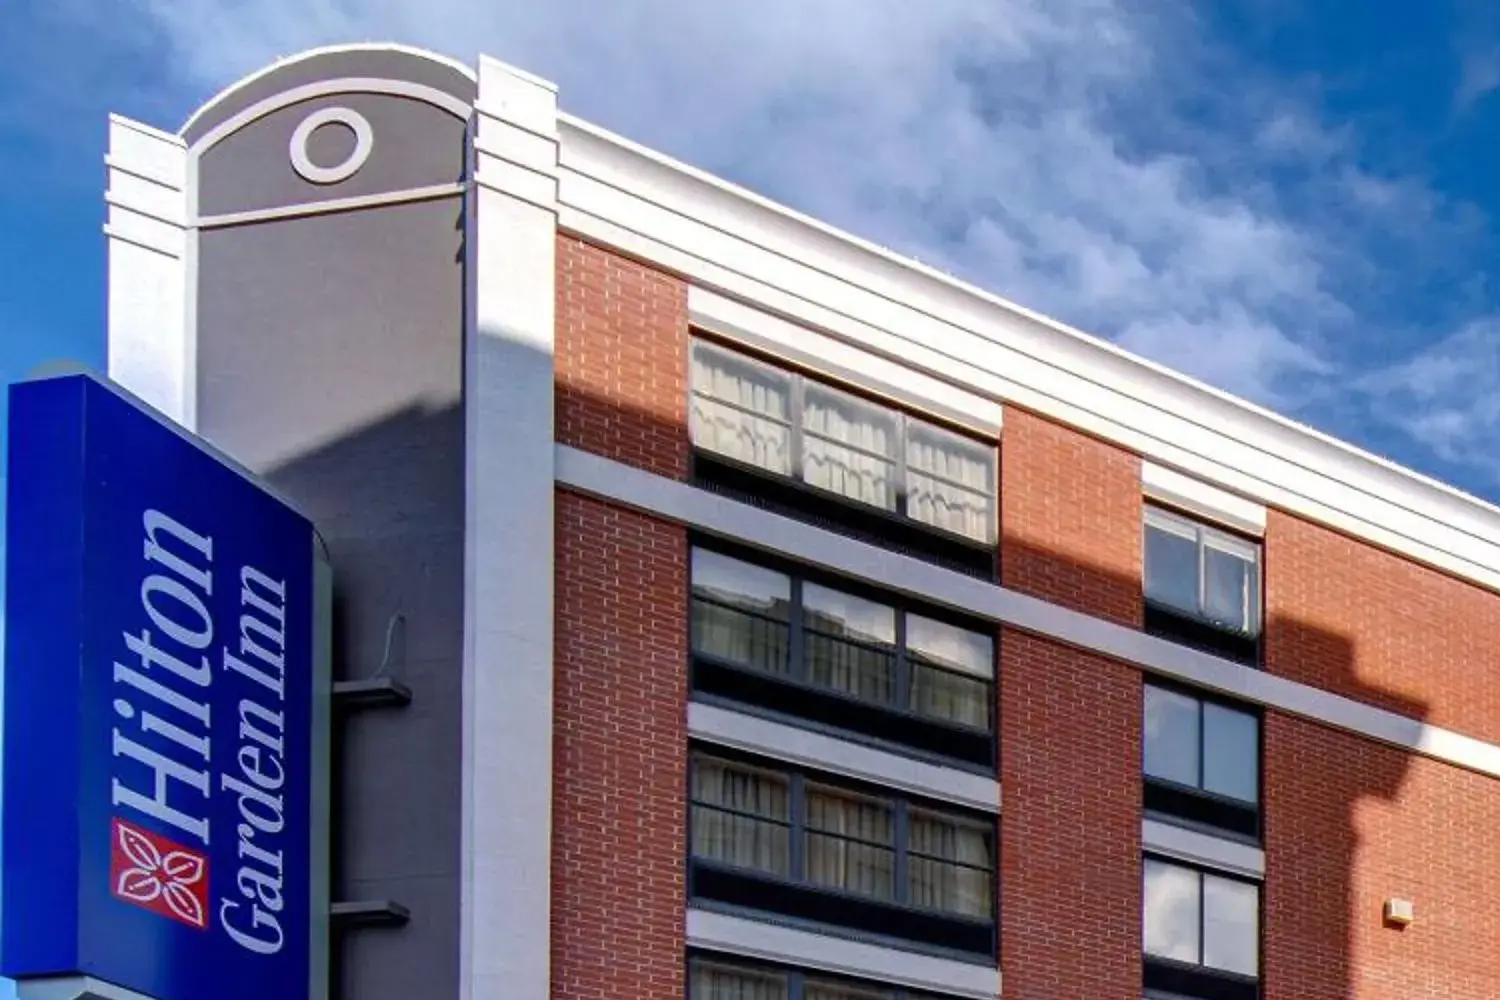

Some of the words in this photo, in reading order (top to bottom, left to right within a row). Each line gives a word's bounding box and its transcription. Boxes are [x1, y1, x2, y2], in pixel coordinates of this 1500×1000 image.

[112, 509, 213, 845] Hilton
[222, 565, 286, 700] Inn
[220, 699, 285, 955] Garden
